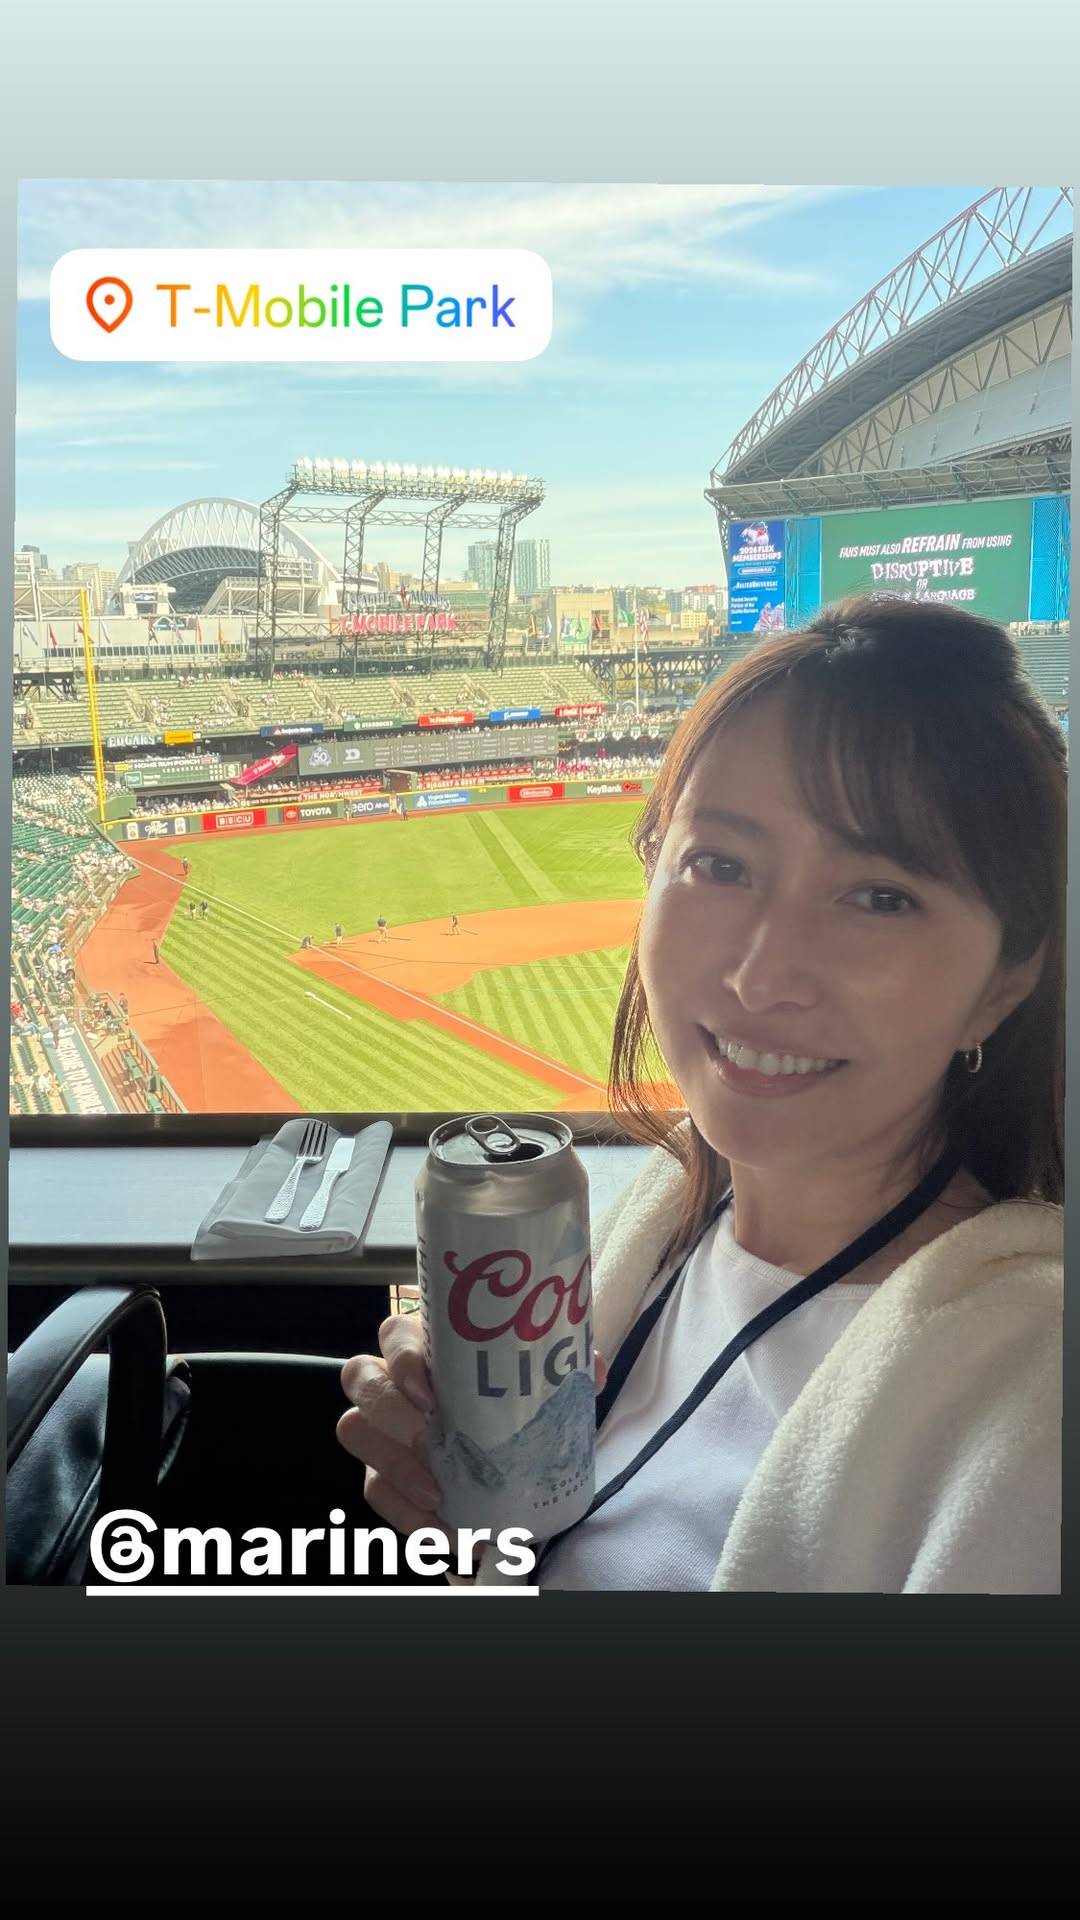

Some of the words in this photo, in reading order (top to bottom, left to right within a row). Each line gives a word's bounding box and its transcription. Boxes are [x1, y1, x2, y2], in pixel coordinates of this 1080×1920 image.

[839, 547, 859, 558] FANS
[859, 545, 881, 557] MUST
[881, 543, 901, 555] ALSO
[901, 533, 961, 554] REFRAIN
[961, 537, 986, 549] FROM
[986, 534, 1013, 547] USING
[871, 557, 975, 581] DISRUPTIVE
[916, 578, 929, 589] OR
[916, 588, 976, 601] LANGUAGE
[586, 784, 622, 795] KeyBank
[300, 806, 331, 817] TOYOTA
